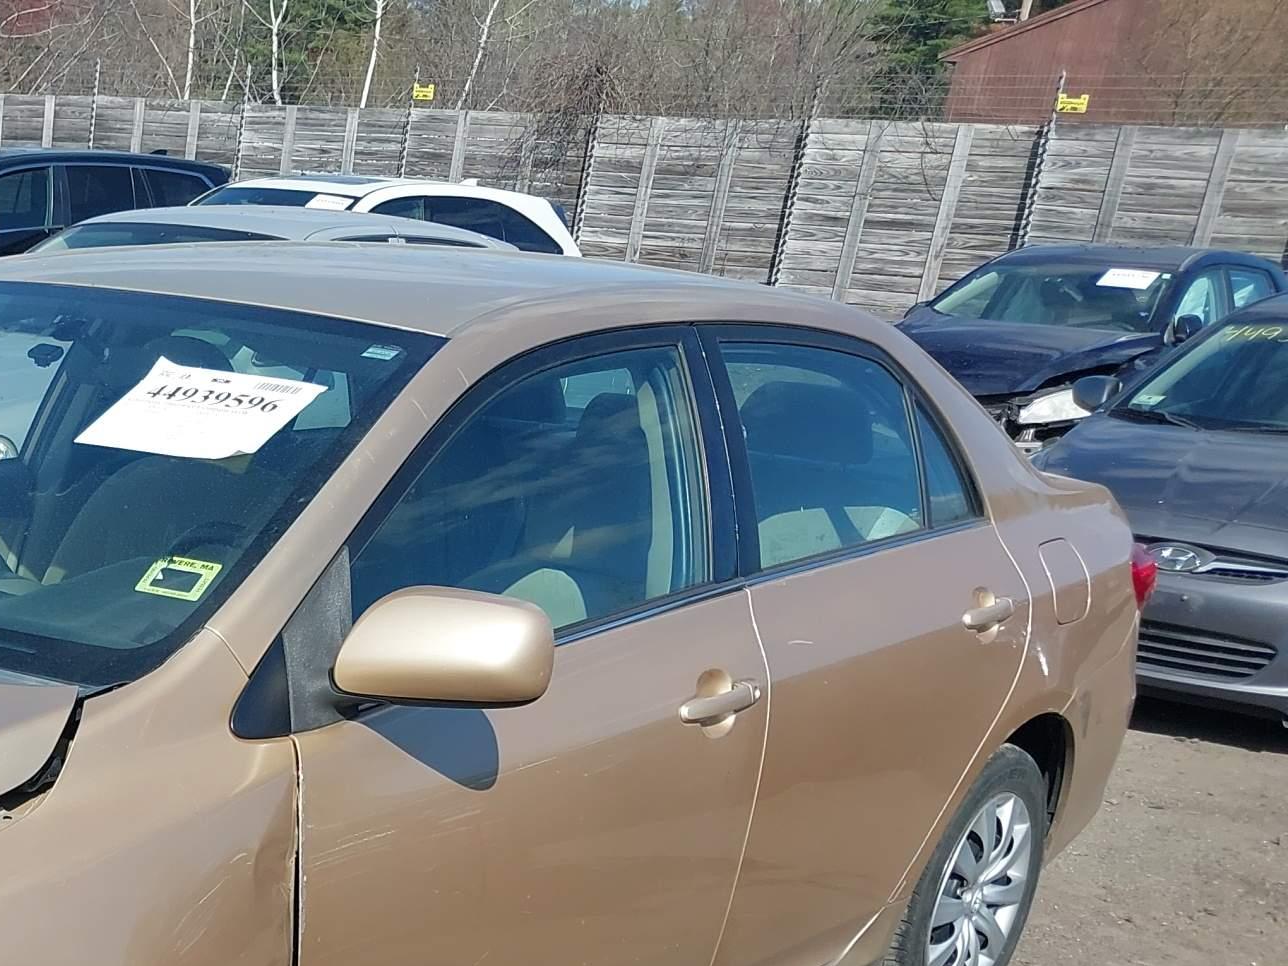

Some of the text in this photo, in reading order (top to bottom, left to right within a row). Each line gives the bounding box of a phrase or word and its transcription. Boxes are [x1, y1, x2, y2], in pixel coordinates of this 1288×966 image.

[1224, 326, 1288, 342] 449
[146, 384, 284, 413] 44939596
[199, 563, 214, 571] MA
